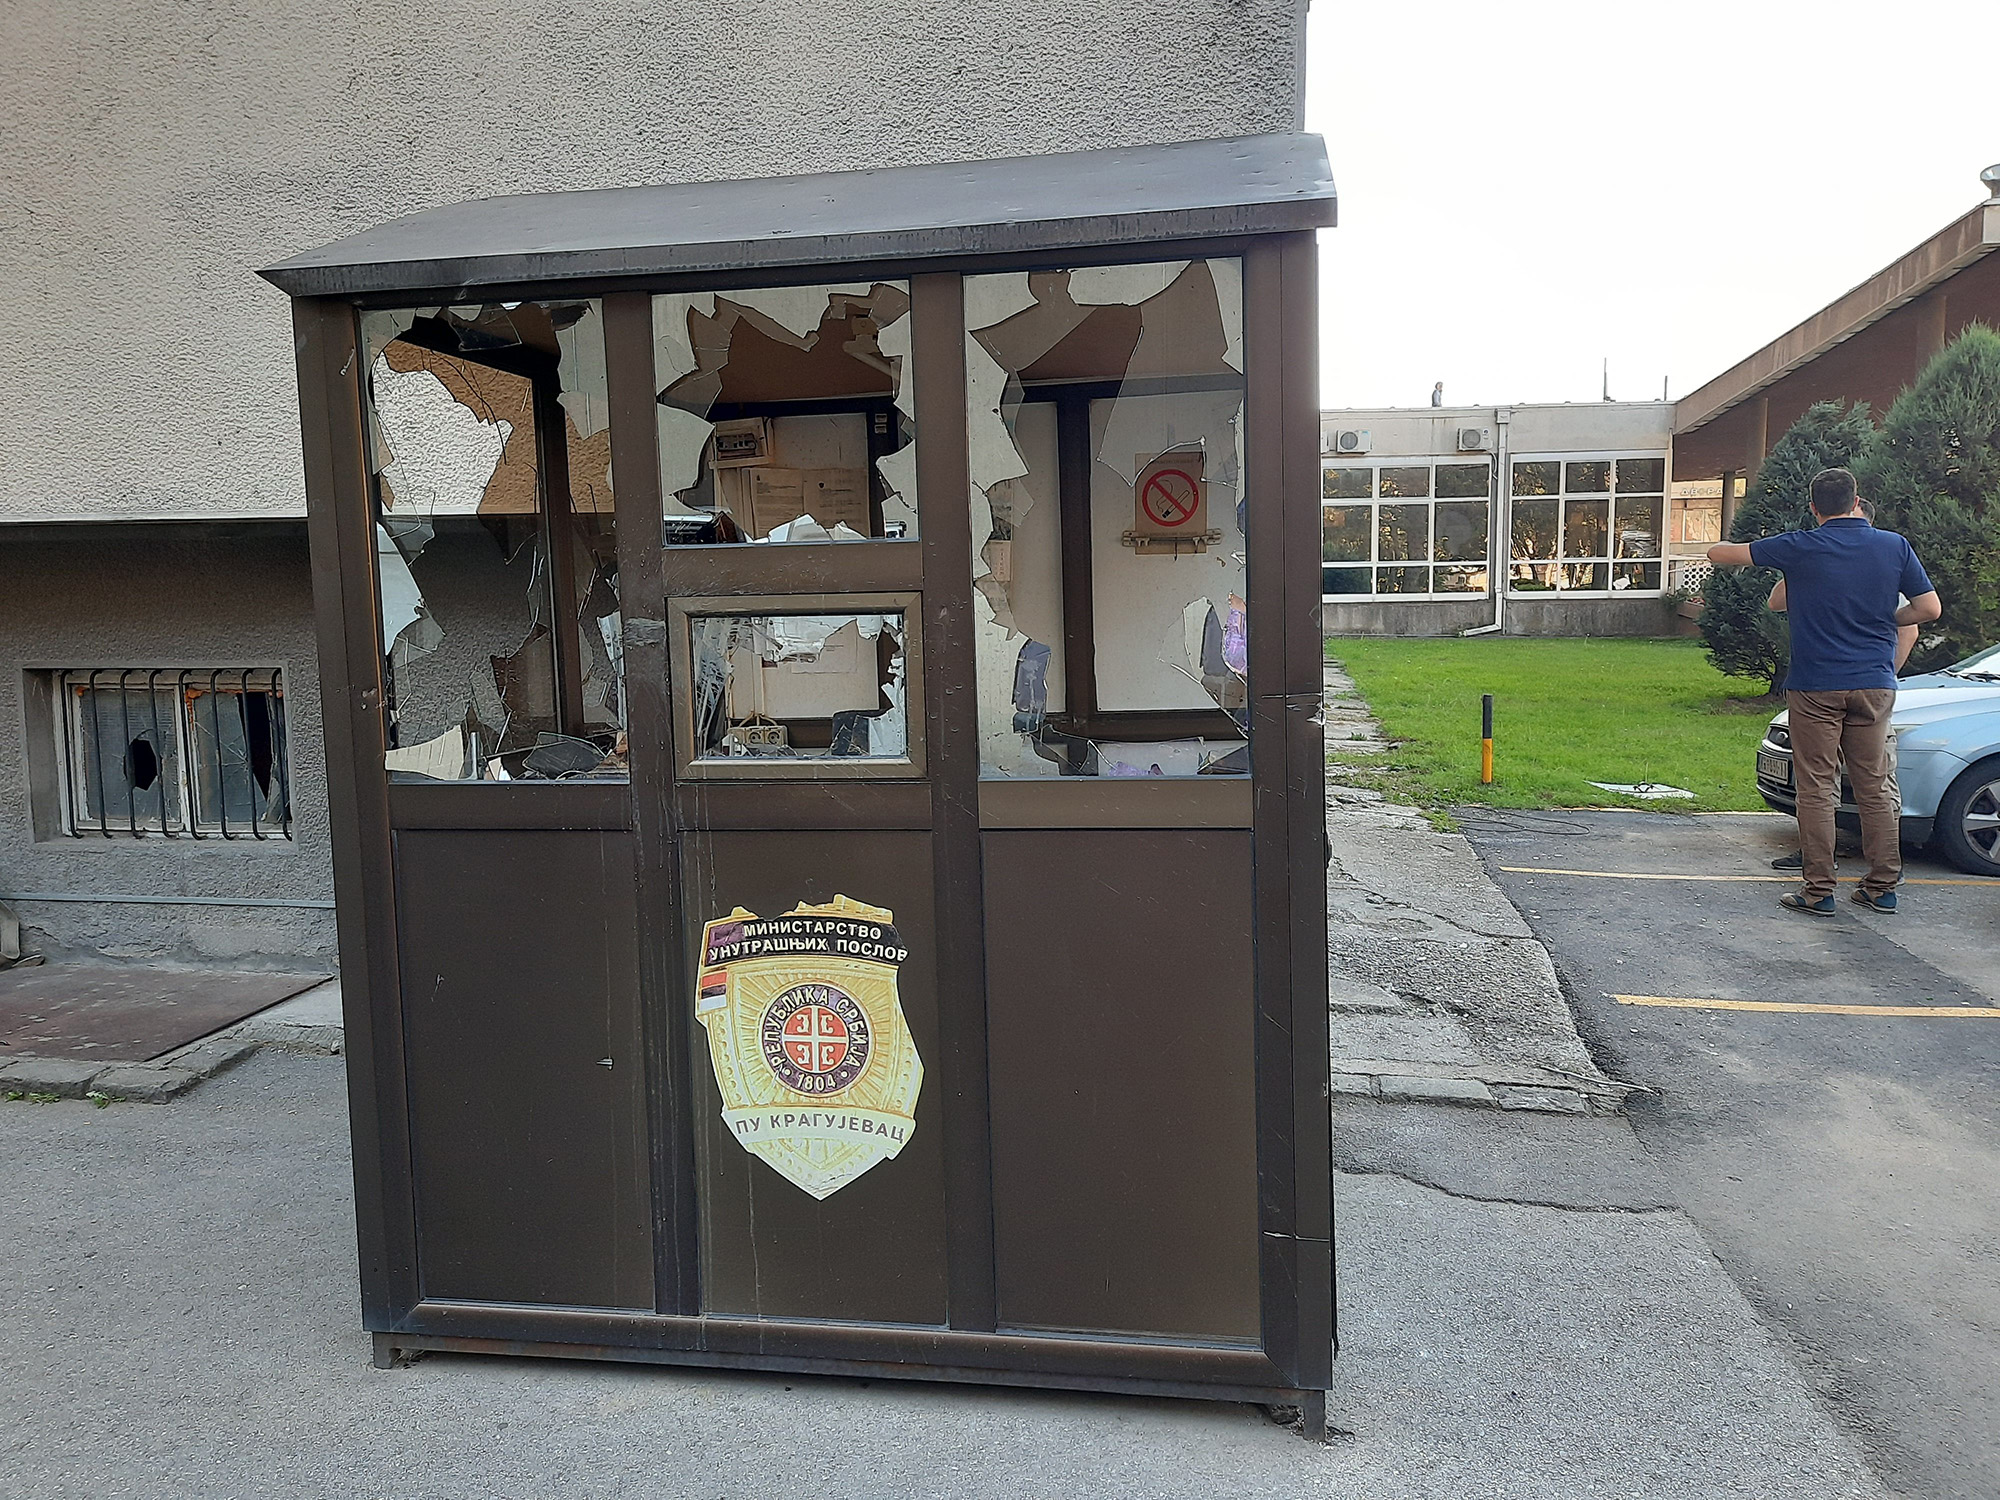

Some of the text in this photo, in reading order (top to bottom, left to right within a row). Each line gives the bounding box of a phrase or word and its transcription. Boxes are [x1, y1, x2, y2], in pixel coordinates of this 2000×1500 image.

[743, 919, 882, 940] МИНИСТАРСТВО
[709, 937, 908, 962] УНУТРАШЊИХ ПОСЛОВ
[764, 986, 867, 1068] РЕПУБЛИКА СРБИЈА
[797, 1072, 837, 1092] 1804
[735, 1112, 905, 1144] ПУ КРАГУЈЕВАЦ
